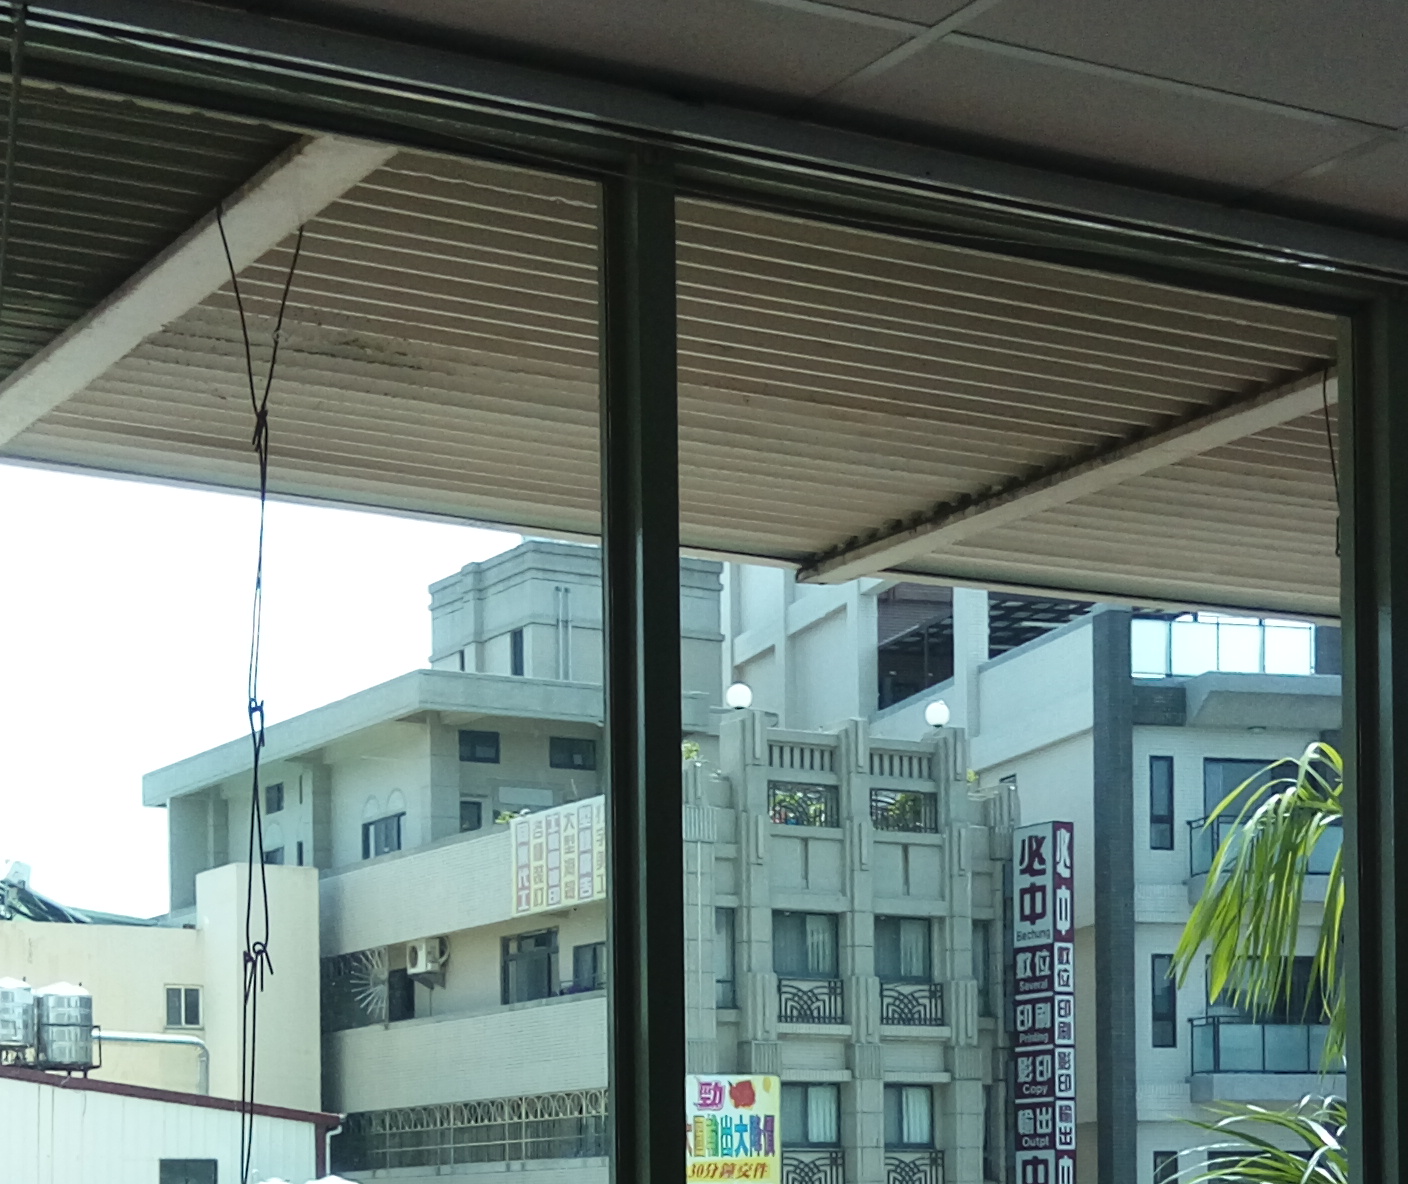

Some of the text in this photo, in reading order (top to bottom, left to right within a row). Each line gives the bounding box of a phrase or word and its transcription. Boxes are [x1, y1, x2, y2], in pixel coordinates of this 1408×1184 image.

[1019, 835, 1047, 925] 必中
[1016, 1002, 1051, 1031] 印刷
[1017, 1054, 1052, 1083] 影印
[1022, 1083, 1048, 1095] Copy
[1017, 1107, 1053, 1136] 輸出
